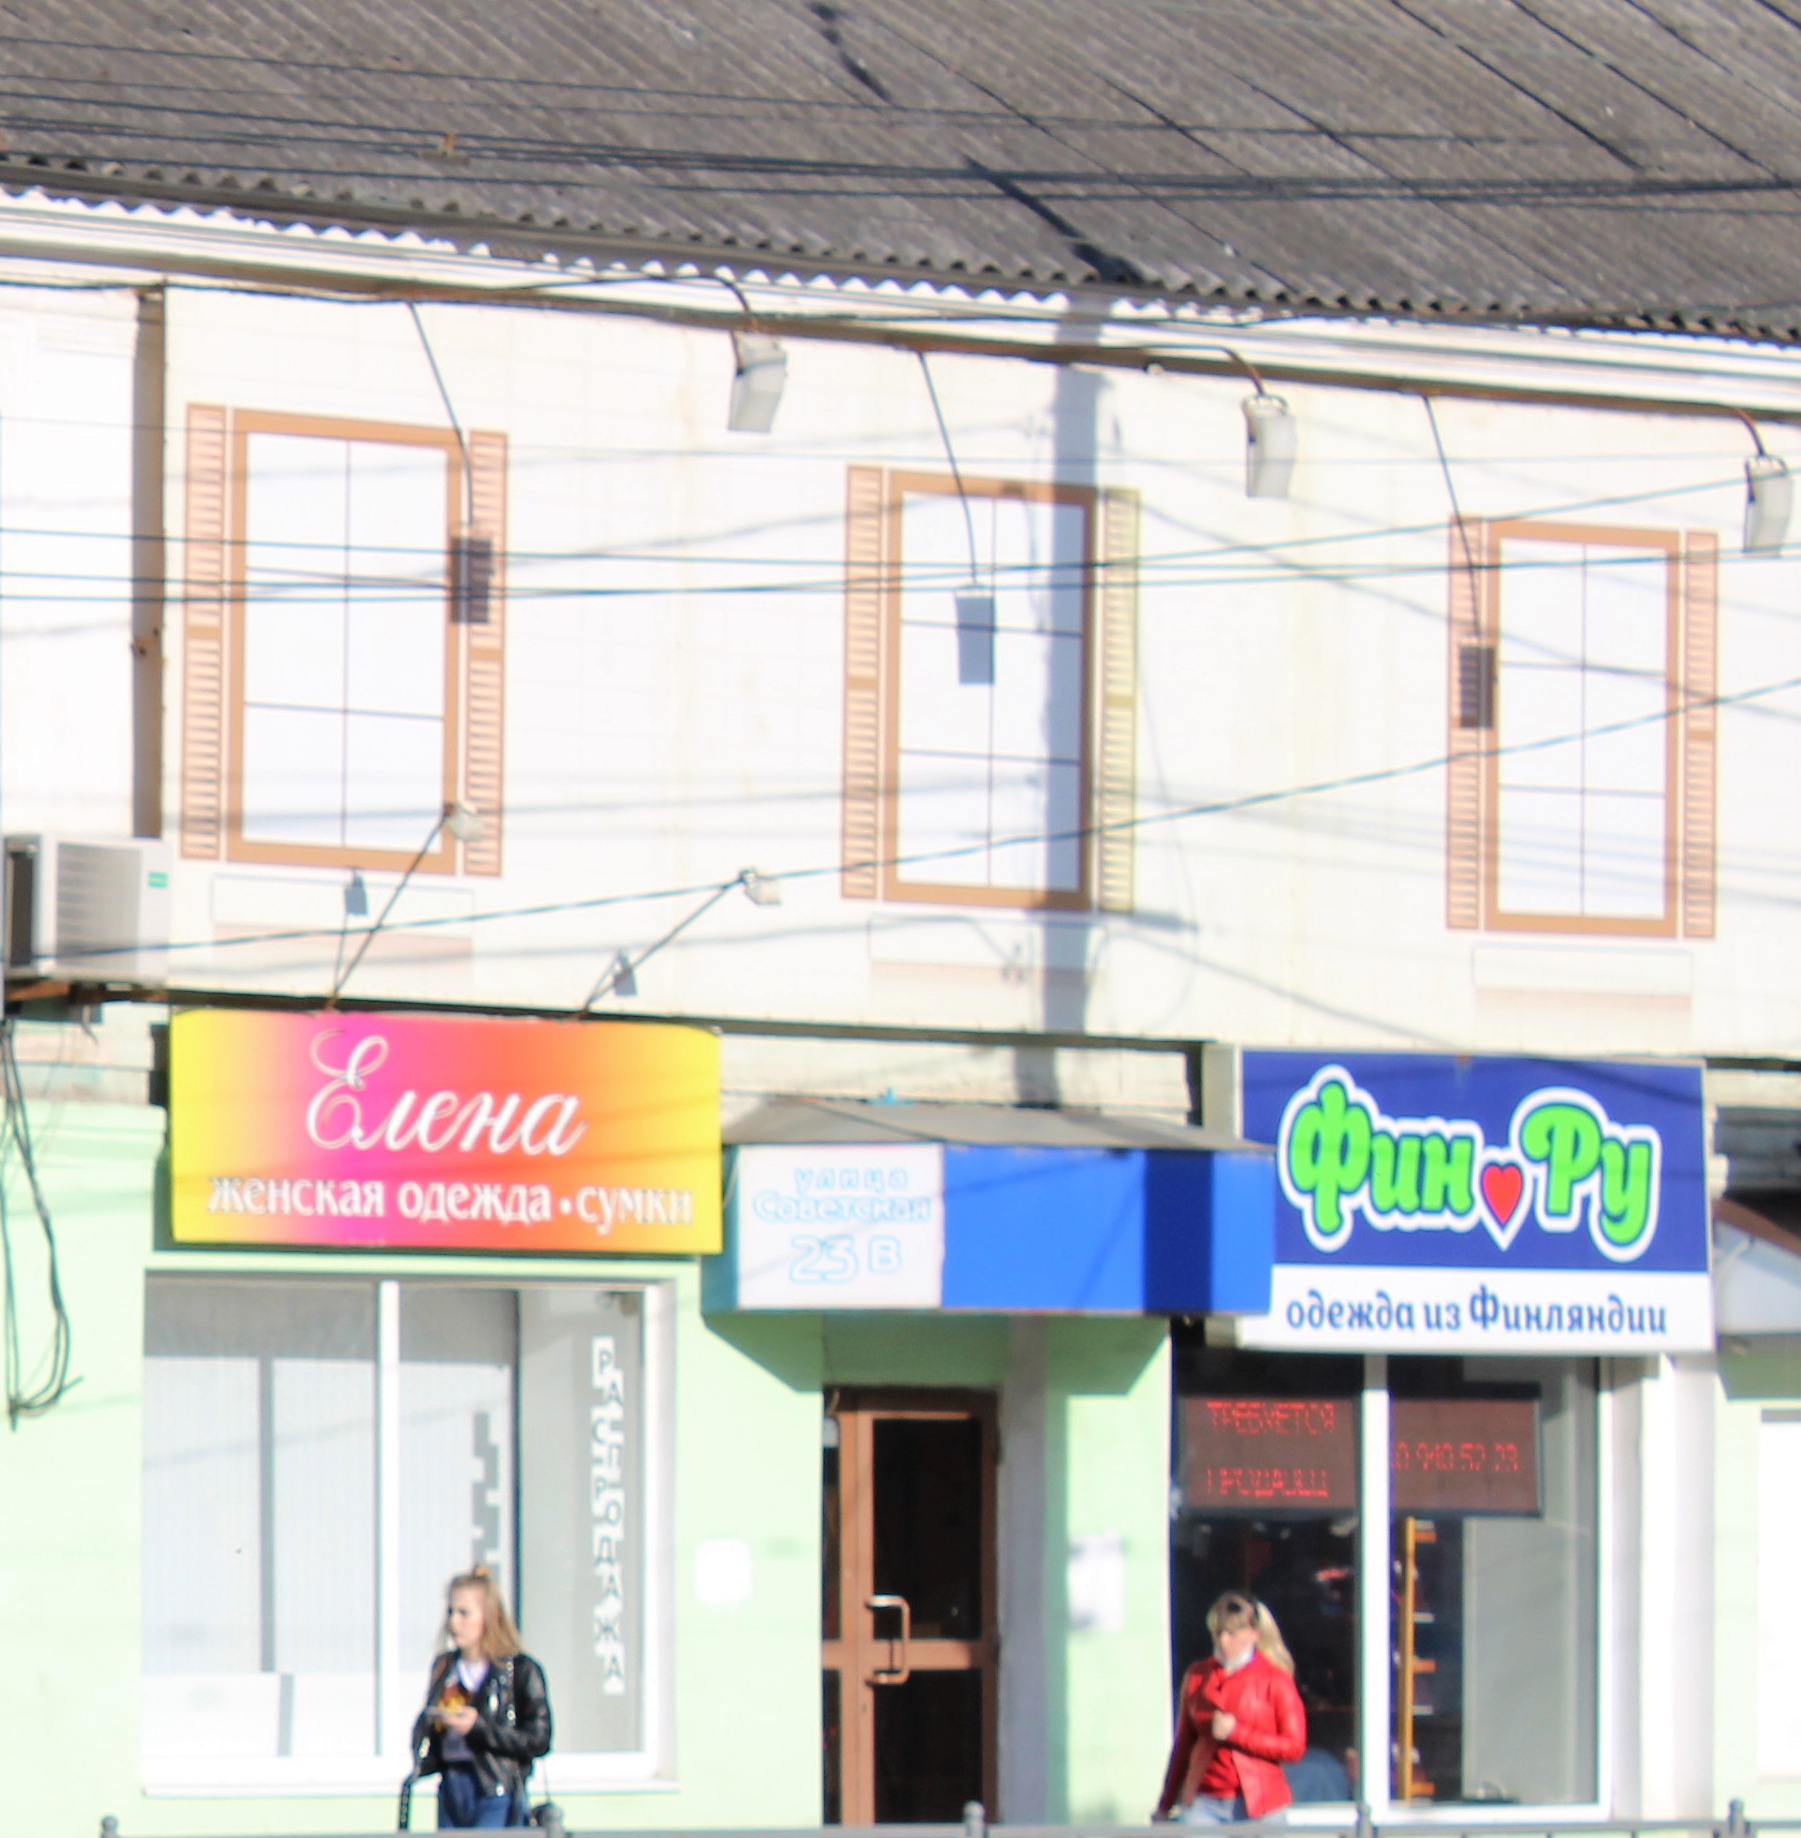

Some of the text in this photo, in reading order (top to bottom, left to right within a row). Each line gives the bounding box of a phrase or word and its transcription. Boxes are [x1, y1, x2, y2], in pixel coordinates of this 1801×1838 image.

[306, 1029, 587, 1157] Елена
[794, 1167, 909, 1194] улица
[1283, 1076, 1659, 1252] Фин Ру
[208, 1176, 693, 1234] женская одежда сумки
[753, 1189, 932, 1222] Советская
[789, 1234, 860, 1284] 23
[1285, 1284, 1669, 1337] одежда из Финляндии
